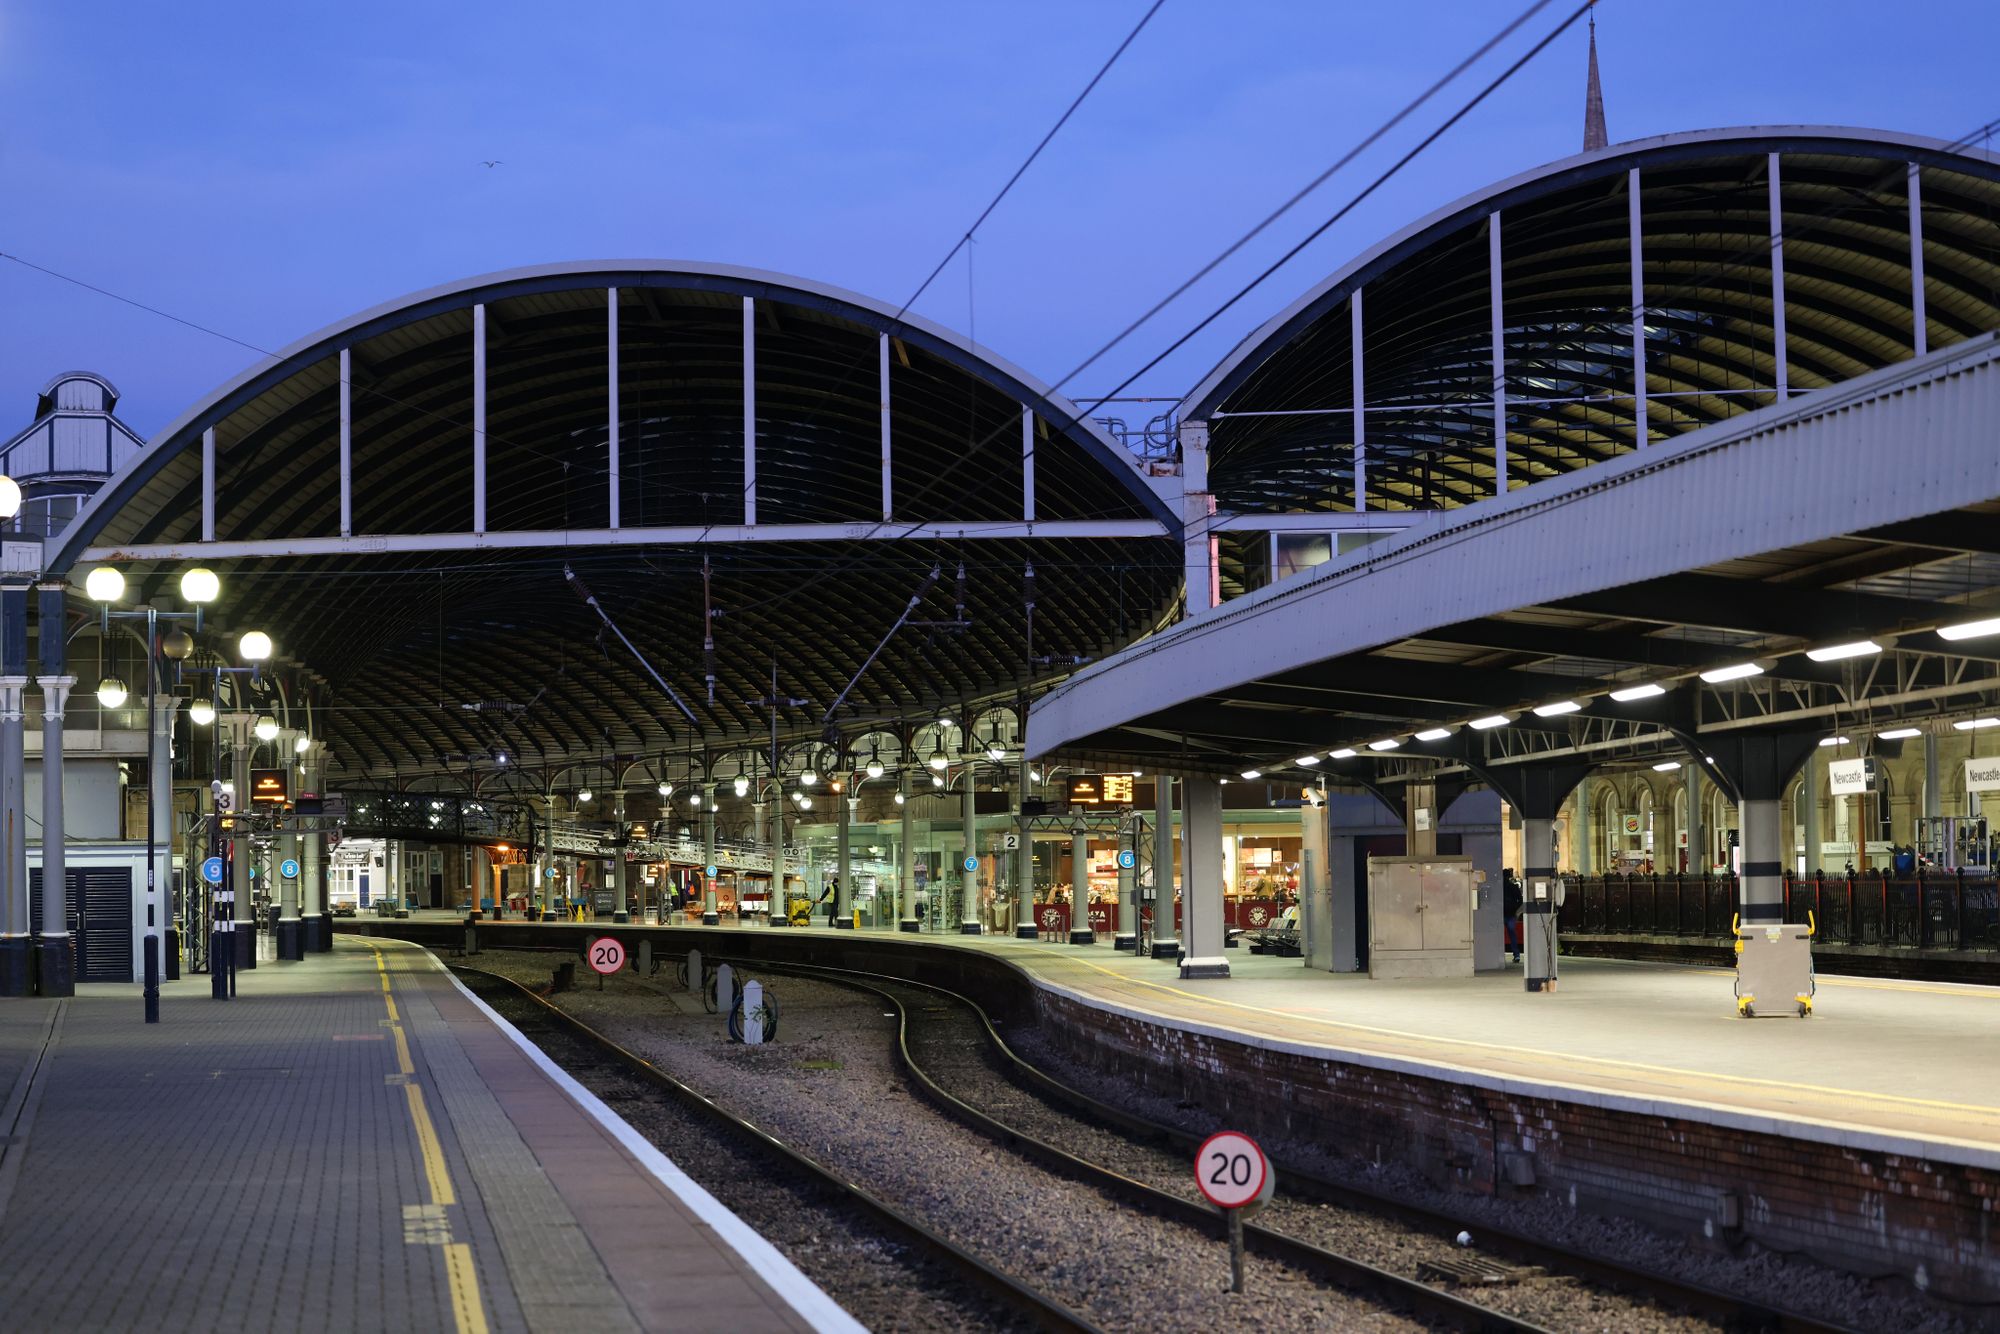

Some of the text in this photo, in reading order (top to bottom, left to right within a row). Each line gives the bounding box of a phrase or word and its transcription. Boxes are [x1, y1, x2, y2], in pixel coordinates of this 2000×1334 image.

[1833, 769, 1862, 785] Newcastle
[1969, 767, 2000, 783] Newcastle
[219, 793, 231, 809] 3
[330, 831, 339, 842] 3
[1007, 836, 1016, 848] 2
[968, 861, 974, 869] 7
[1124, 855, 1131, 865] 8
[210, 865, 221, 878] 9
[286, 865, 294, 875] 8
[596, 946, 619, 965] 20
[1210, 1152, 1251, 1186] 20
